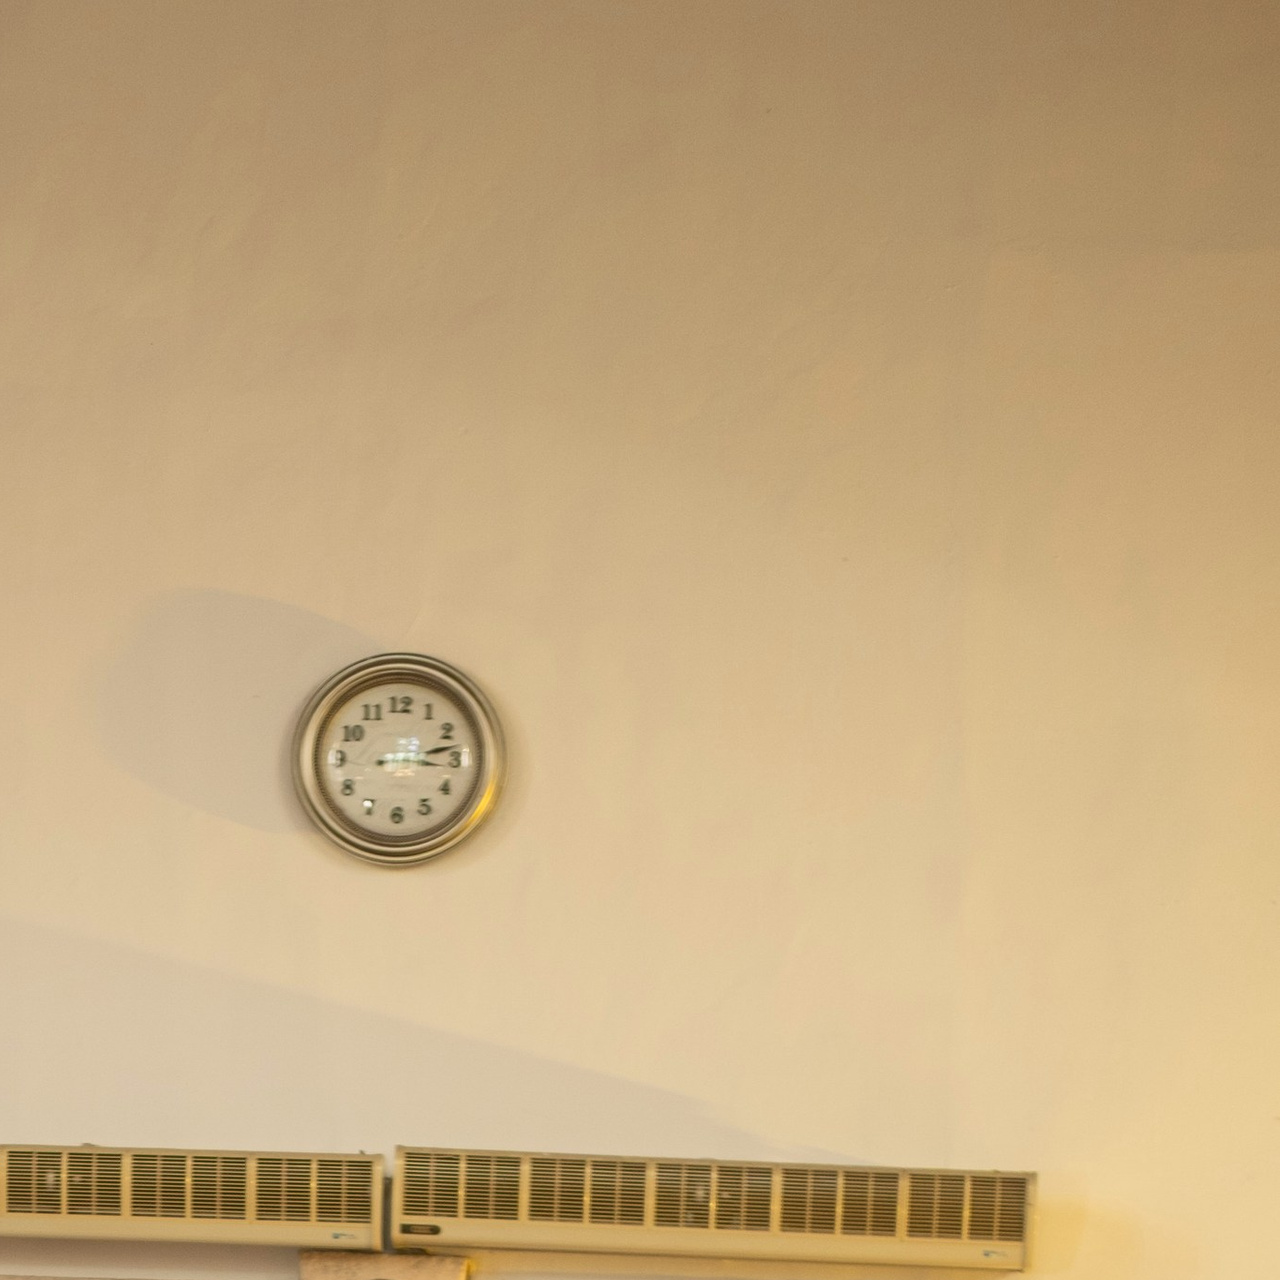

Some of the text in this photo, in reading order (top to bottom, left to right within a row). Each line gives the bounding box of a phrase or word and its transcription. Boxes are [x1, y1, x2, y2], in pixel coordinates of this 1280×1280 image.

[361, 703, 383, 721] 11
[388, 696, 414, 714] 12
[423, 703, 434, 720] 1
[342, 724, 365, 742] 10
[439, 722, 454, 740] 2
[448, 750, 462, 768] 3
[341, 778, 355, 796] 8
[438, 778, 451, 796] 4
[390, 806, 404, 824] 6
[417, 798, 432, 816] 5
